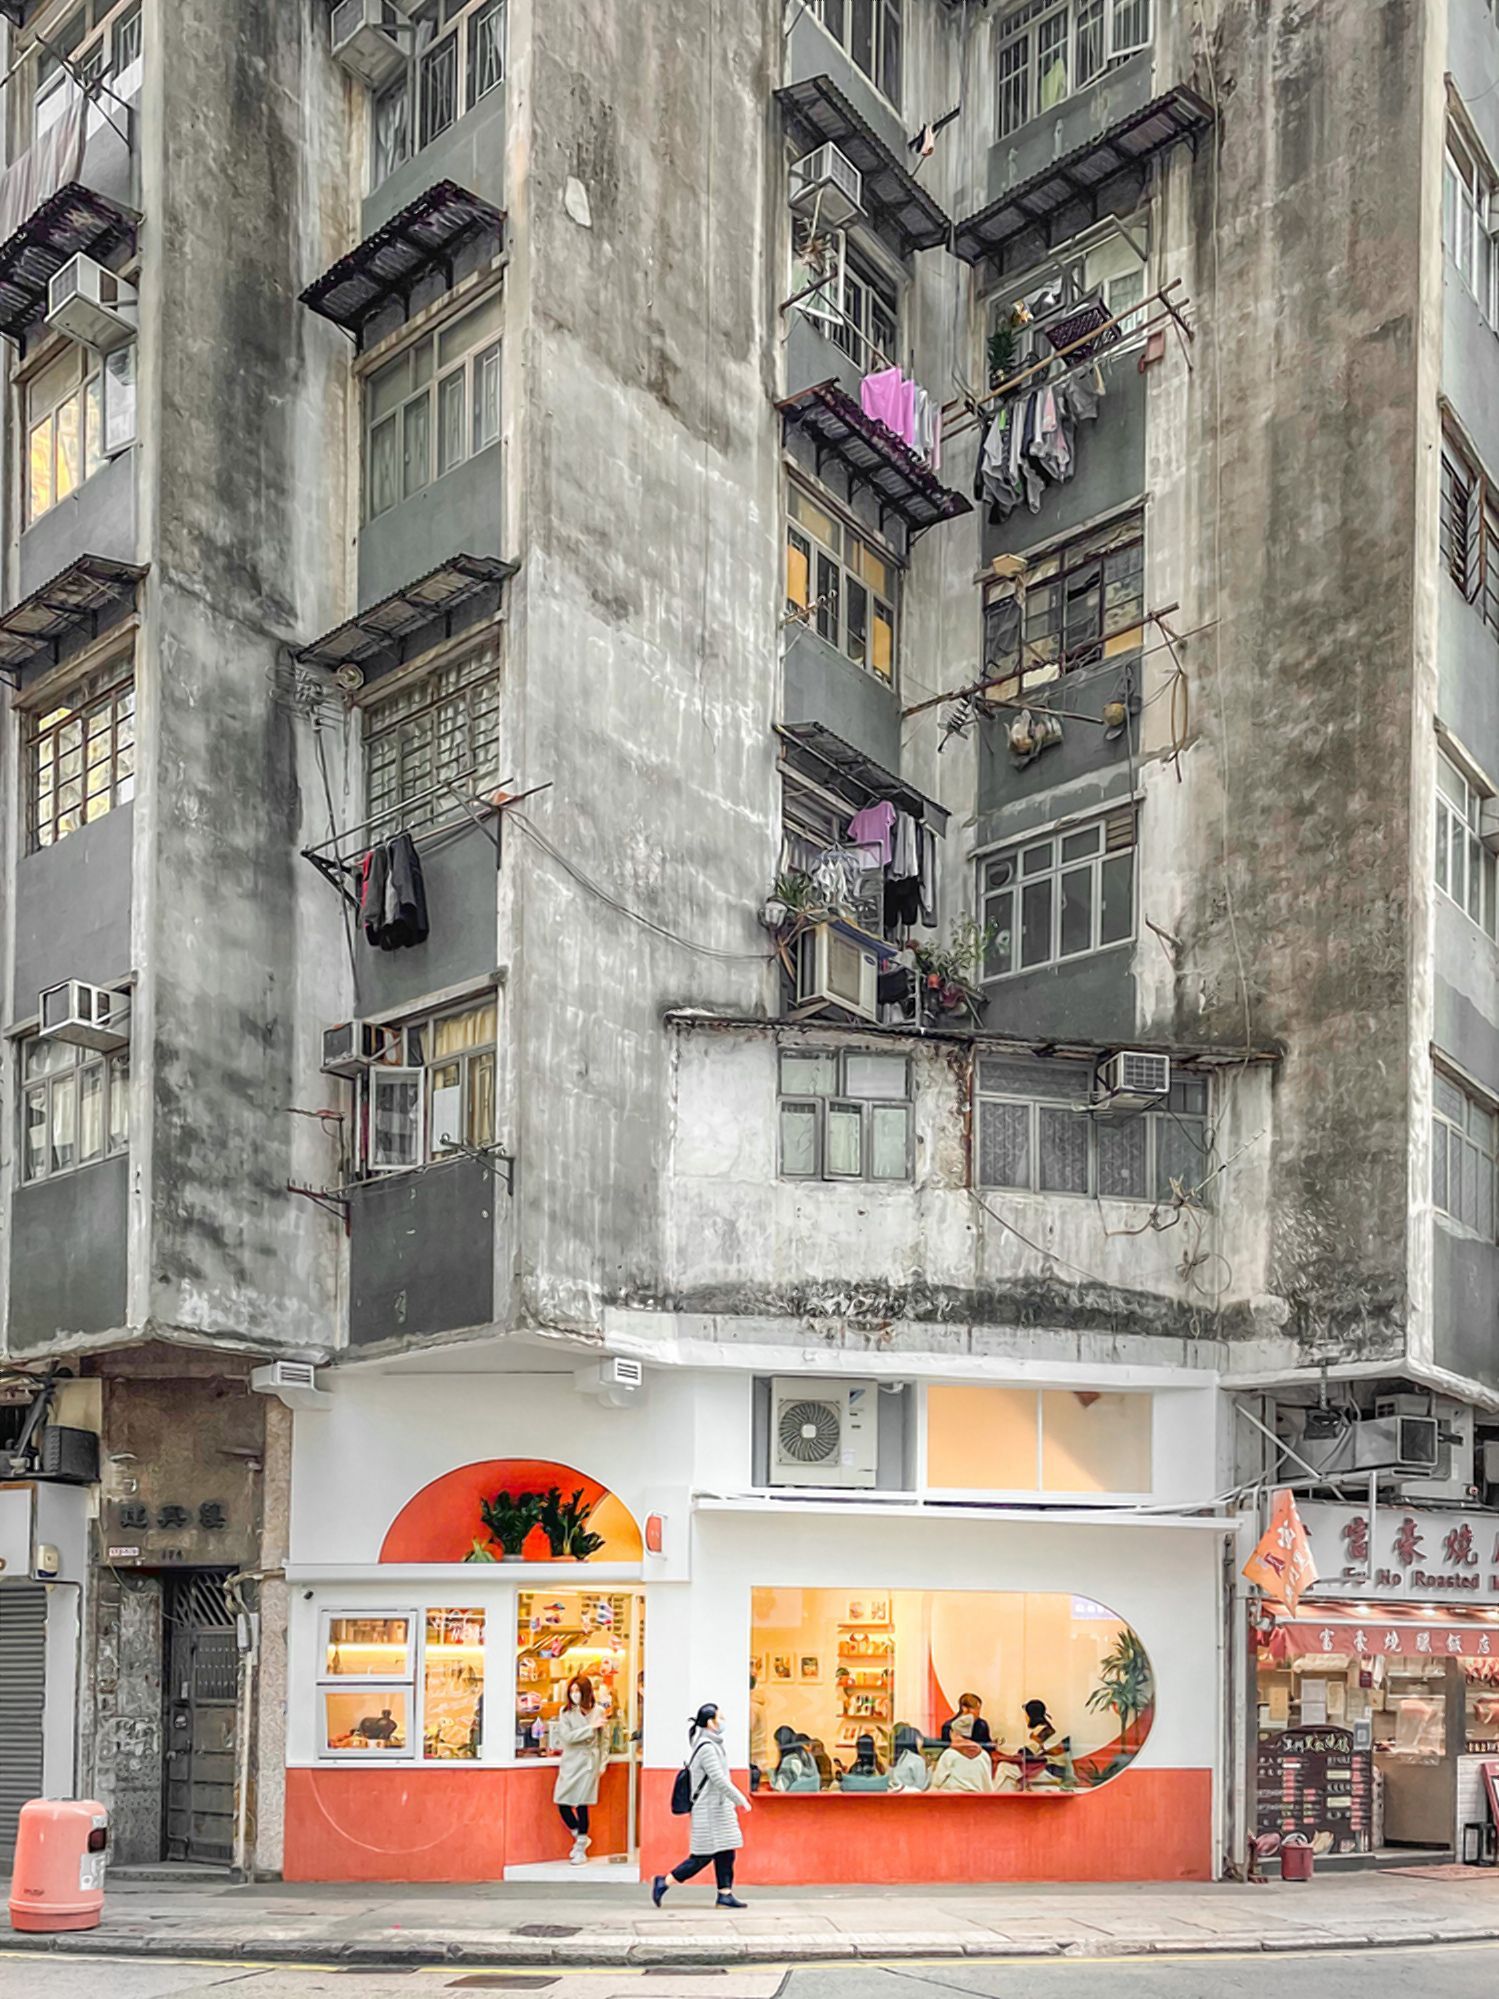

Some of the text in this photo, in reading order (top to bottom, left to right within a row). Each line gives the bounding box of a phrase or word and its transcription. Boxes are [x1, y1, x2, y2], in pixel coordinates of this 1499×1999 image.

[1343, 1516, 1499, 1566] 富豪燒
[1413, 1570, 1480, 1589] Roasted
